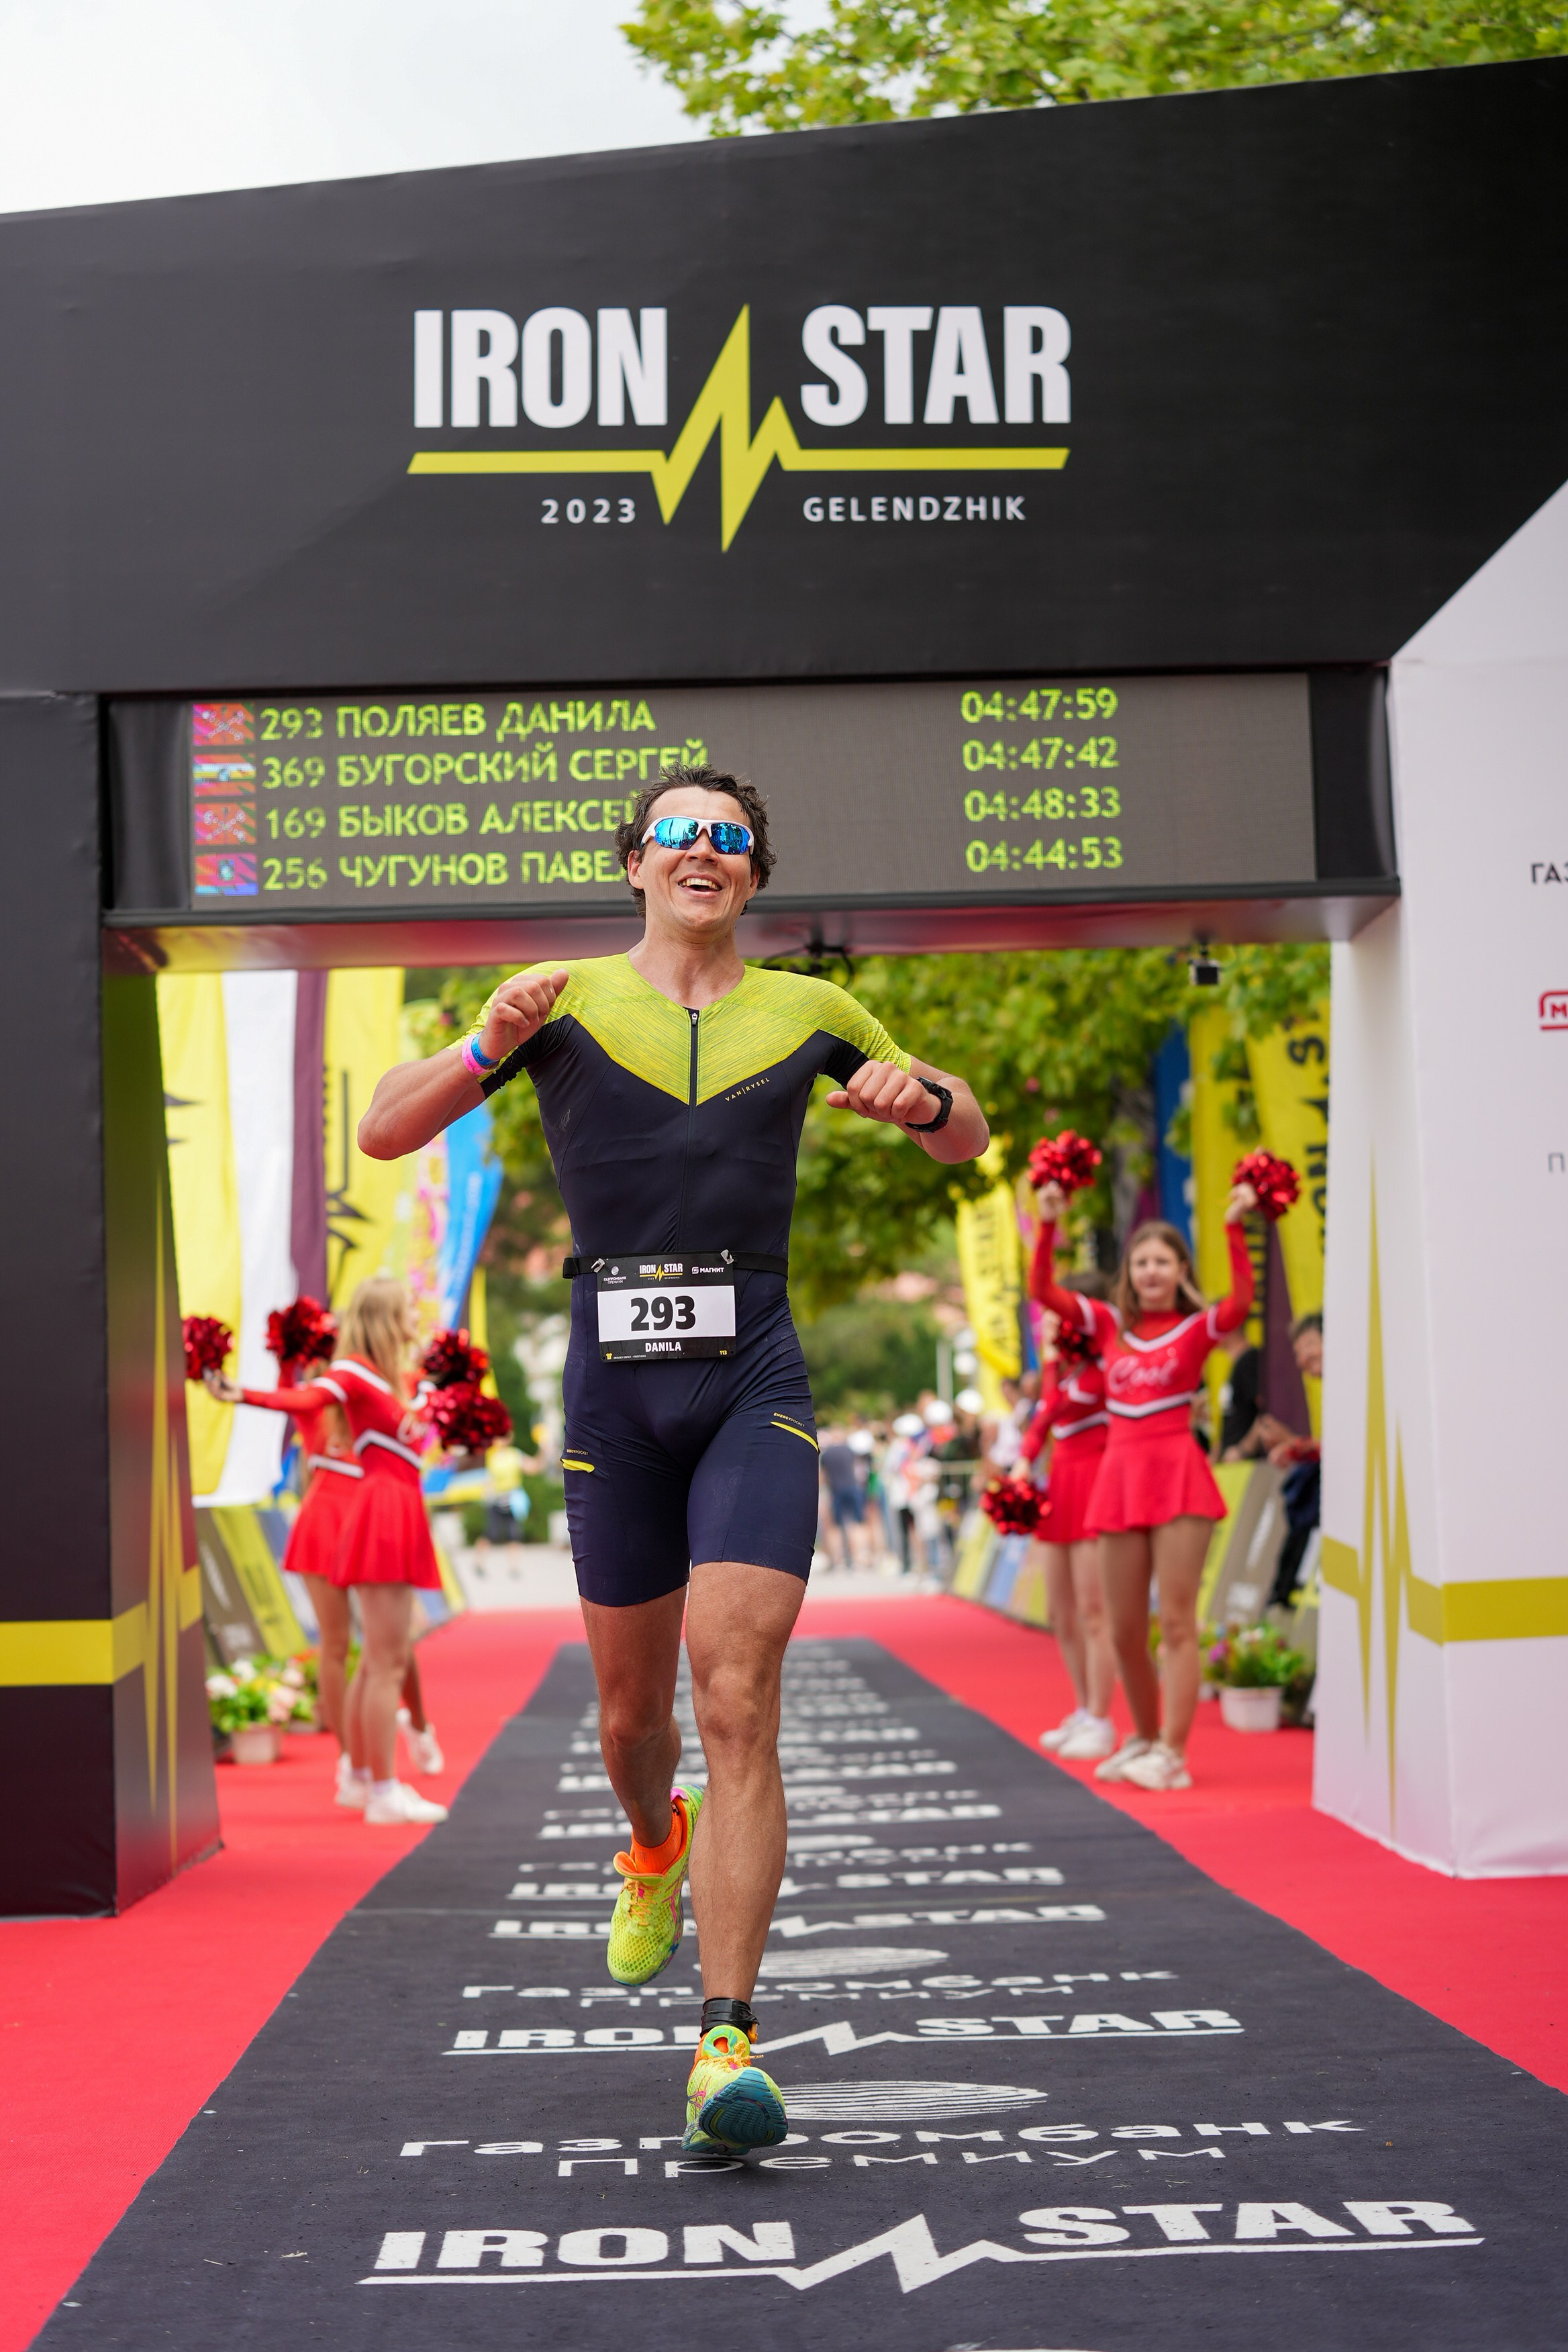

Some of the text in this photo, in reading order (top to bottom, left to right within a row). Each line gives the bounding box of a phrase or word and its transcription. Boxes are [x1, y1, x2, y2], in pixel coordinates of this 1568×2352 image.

[413, 304, 1071, 428] IRON STAR
[541, 495, 1026, 524] 2023 GELENDZHIK
[260, 687, 1119, 742] 293 ПОЛЯЕВ ДАНИЛА 04:47:59
[262, 756, 326, 789] 369
[338, 741, 558, 787] БУГОРСКИЙ
[962, 736, 1120, 771] 04:47:42
[265, 806, 327, 840] 169
[338, 801, 469, 838] БЫКОВ
[964, 786, 1122, 822] 04:48:33
[262, 858, 328, 891] 256
[338, 851, 509, 887] ЧУГУНОВ
[965, 836, 1124, 873] 04:44:53
[639, 1263, 683, 1274] IRON STAR
[630, 1295, 696, 1332] 293
[645, 1341, 682, 1353] DANILA
[917, 2009, 1242, 2037] STAR
[558, 2147, 1226, 2178] Премиум
[375, 2200, 1477, 2270] IRON STAR
